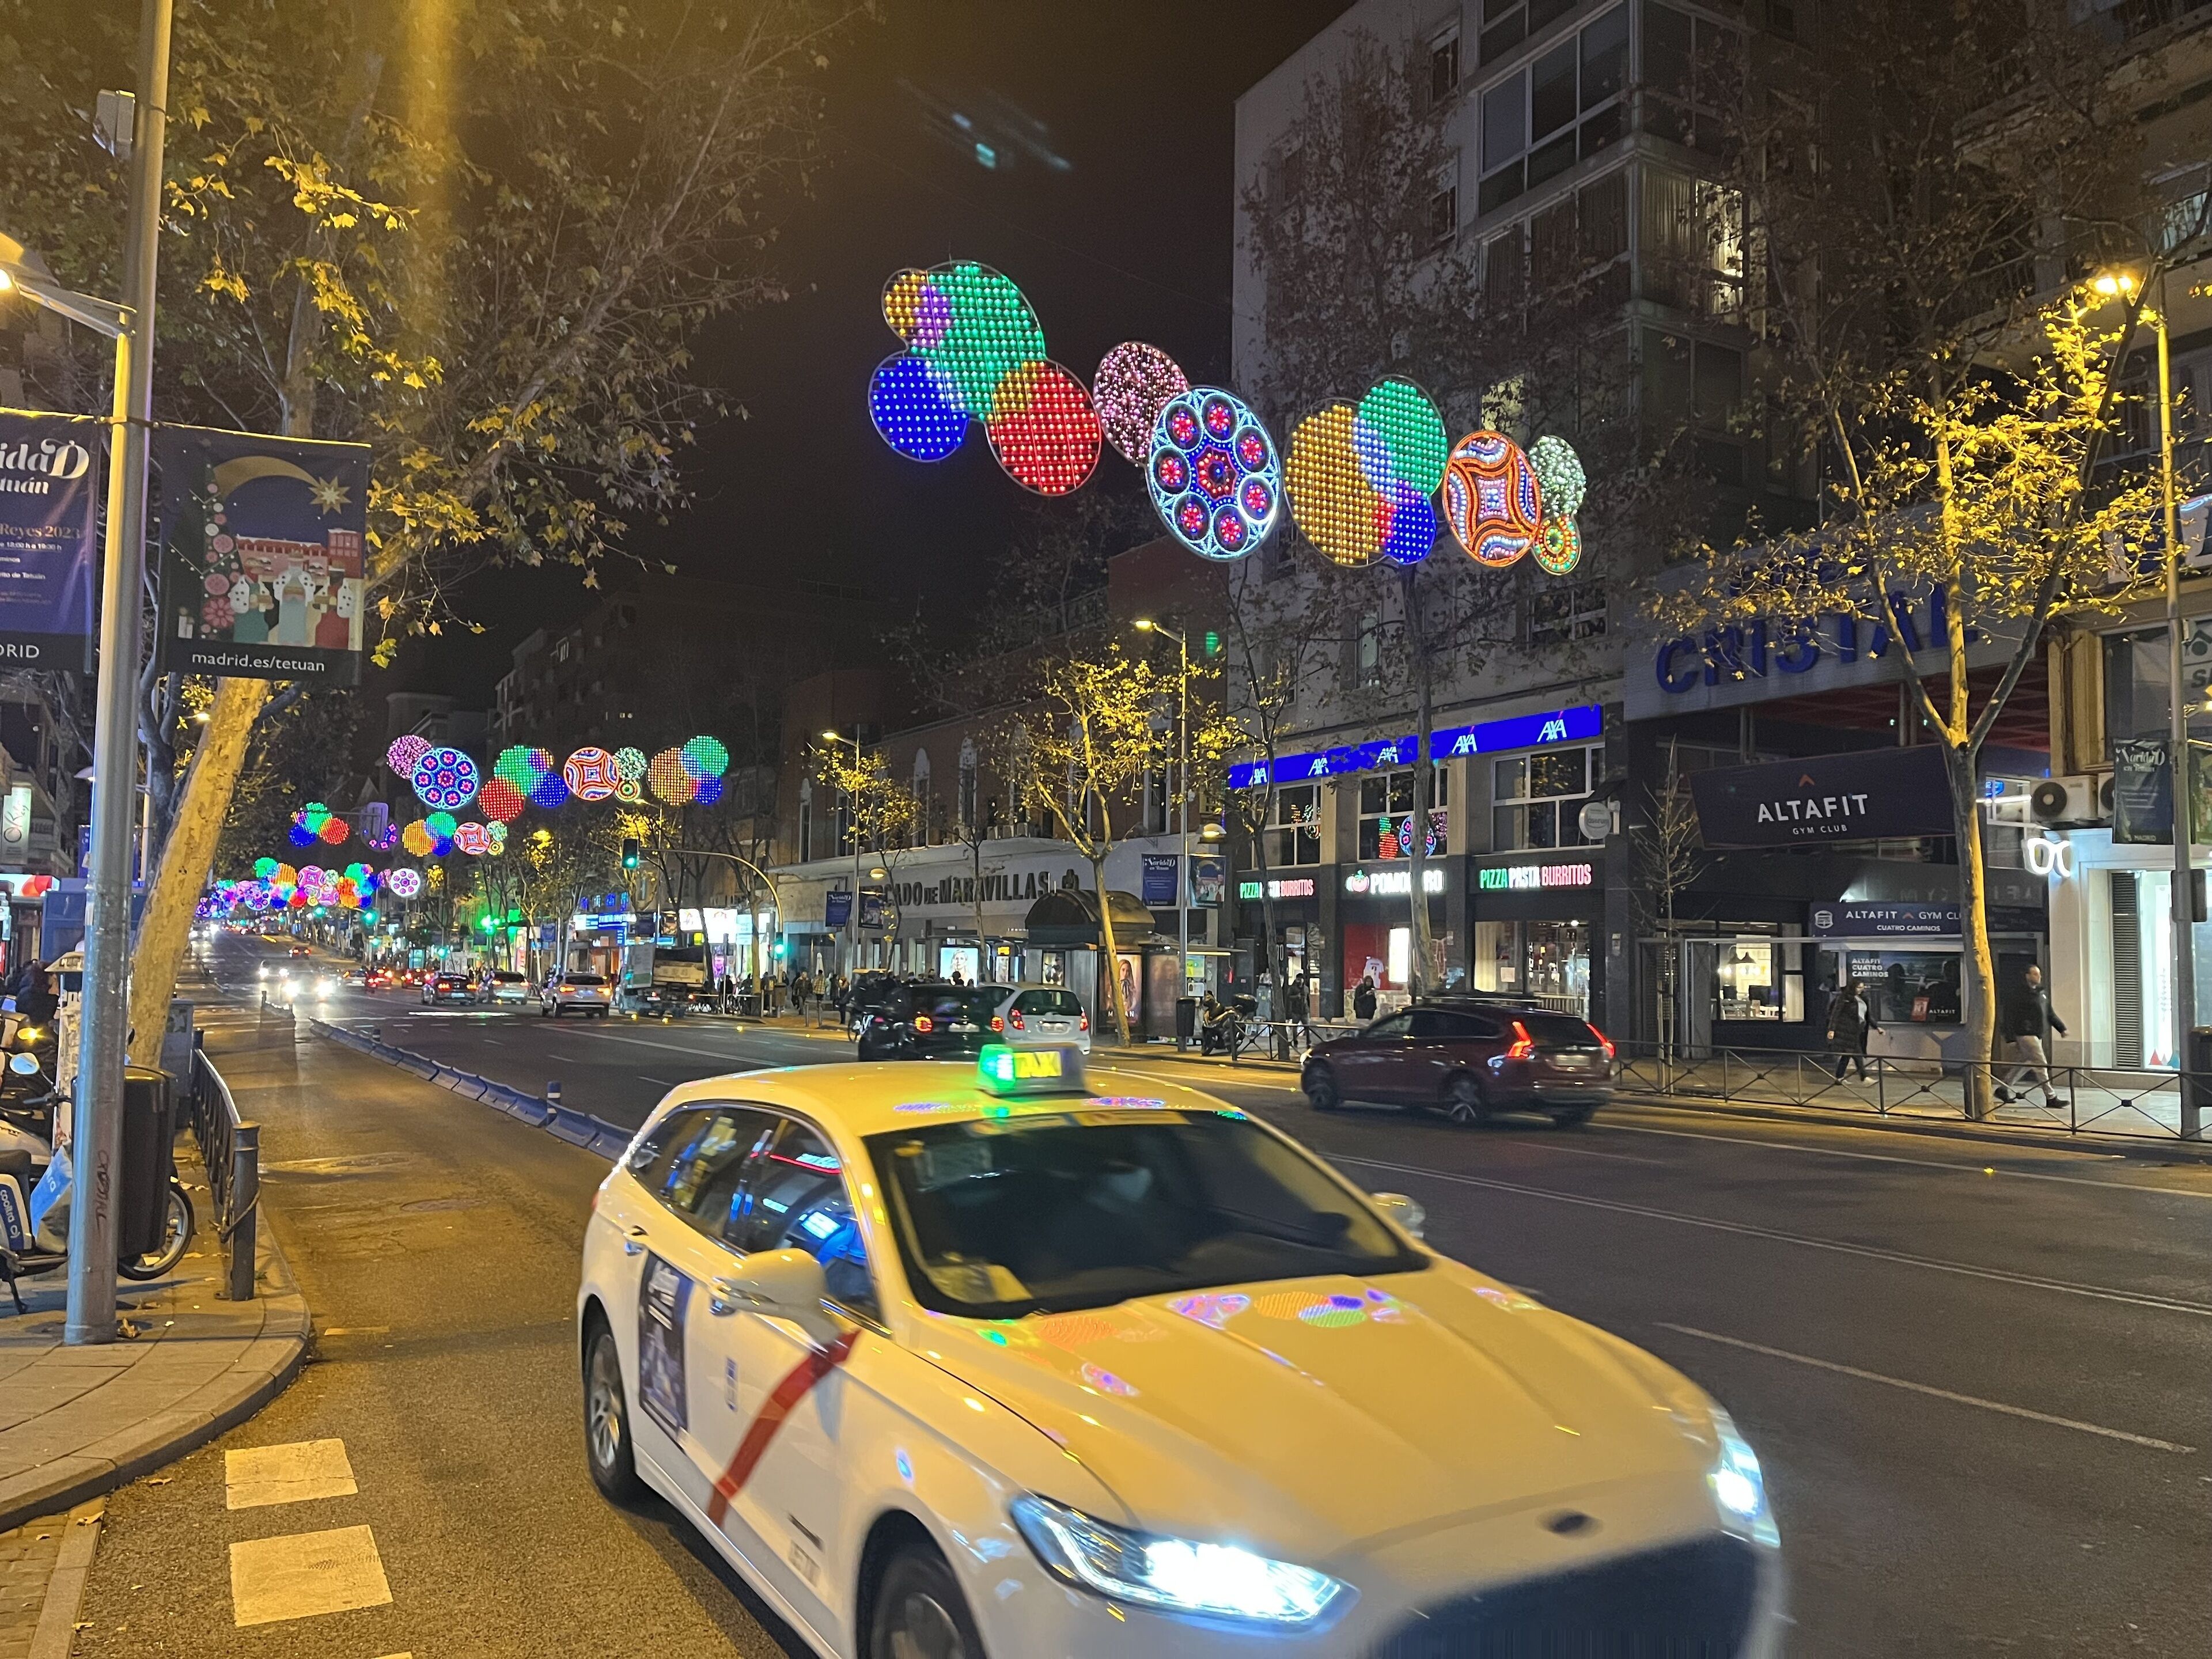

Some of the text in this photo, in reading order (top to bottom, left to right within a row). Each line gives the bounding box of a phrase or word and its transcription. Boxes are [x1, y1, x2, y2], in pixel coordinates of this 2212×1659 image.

[192, 652, 325, 672] madrid.es/tetuan
[1537, 719, 1567, 743] AXA
[1452, 733, 1478, 753] AXA
[1376, 746, 1399, 764] AXA
[1308, 757, 1330, 777] AXA
[1758, 794, 1868, 823] ALTAFIT
[1793, 824, 1848, 835] GYM CLUB
[1480, 863, 1592, 889] PIZZA PASTA BURRITOS
[923, 887, 939, 904] DE
[939, 871, 1050, 904] MARAVILLAS
[1240, 881, 1260, 899] PIZZA
[1280, 878, 1314, 897] BURRITOS
[1845, 911, 1897, 919] ALTAFIT
[1918, 911, 1942, 920] GYM
[0, 1190, 15, 1223] cooltra
